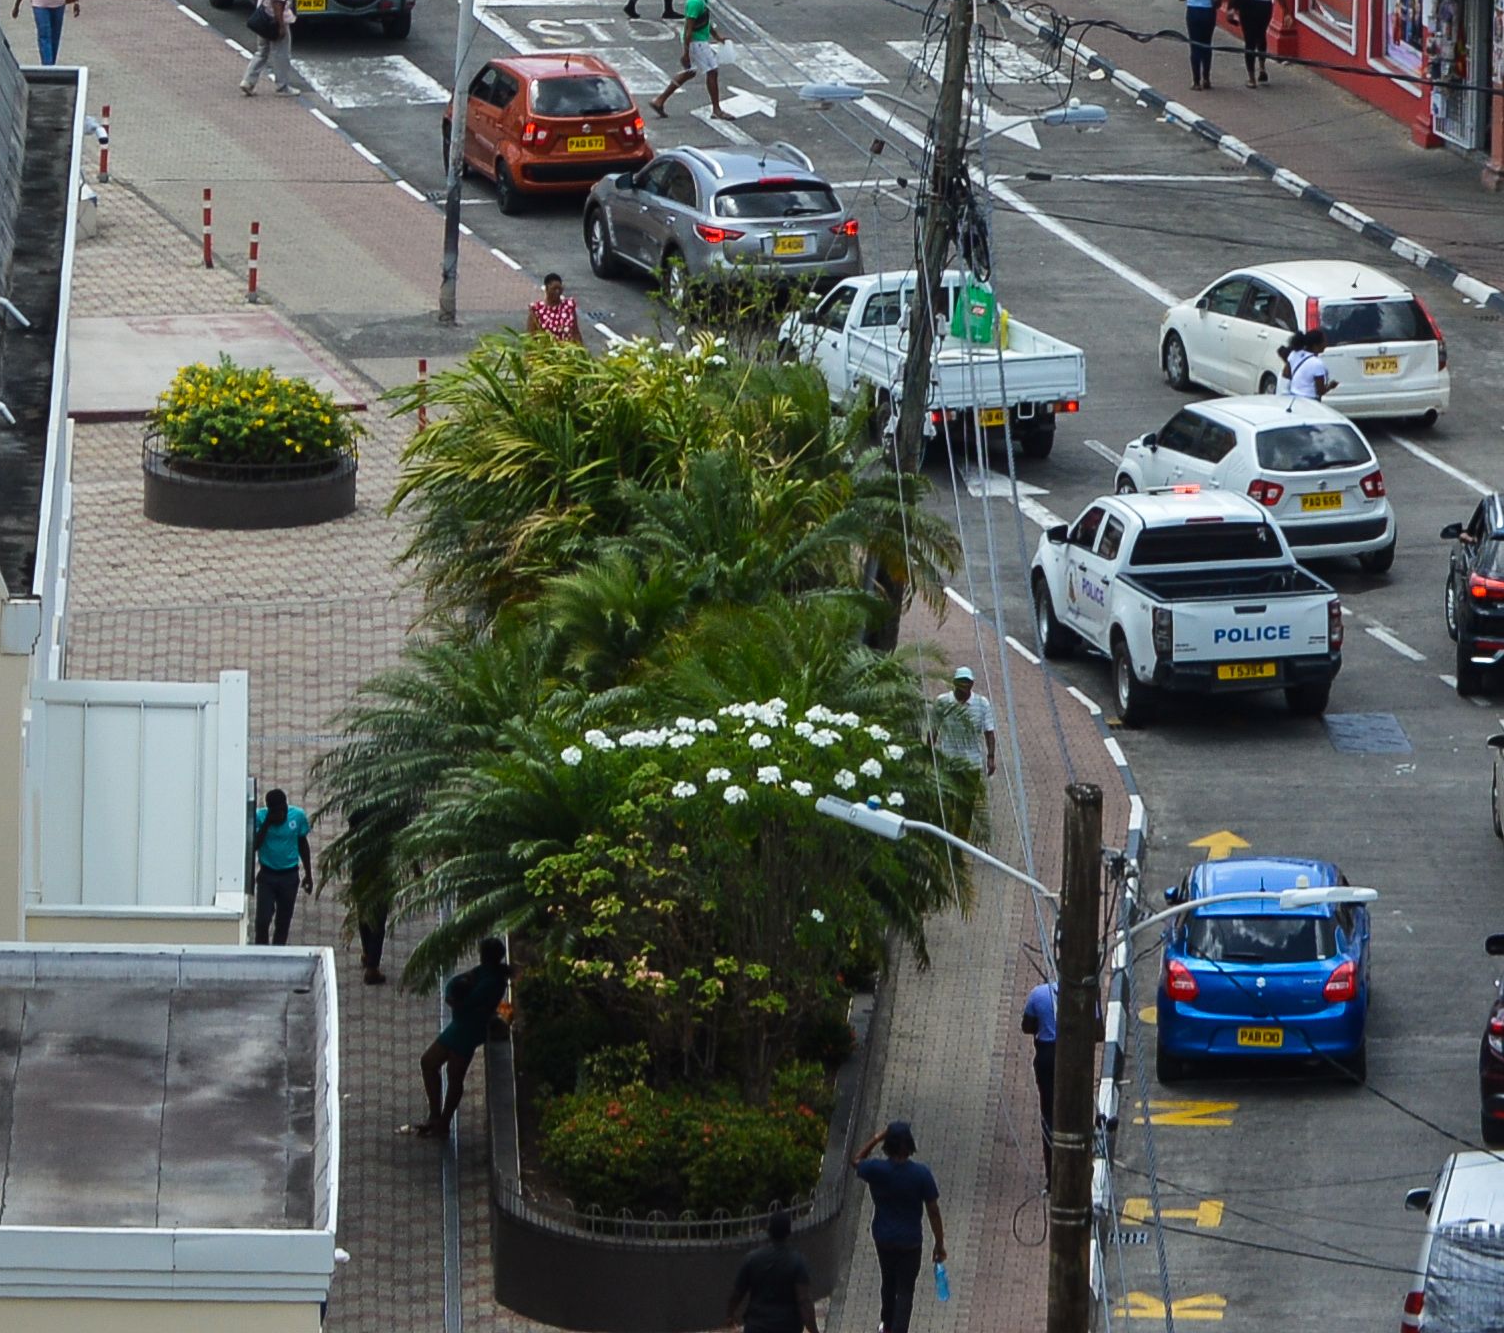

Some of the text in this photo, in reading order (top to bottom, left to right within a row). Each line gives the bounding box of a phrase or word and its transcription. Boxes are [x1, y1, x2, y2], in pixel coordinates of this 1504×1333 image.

[527, 18, 702, 45] STO
[1082, 577, 1105, 607] POLICE
[1214, 625, 1291, 643] POLICE
